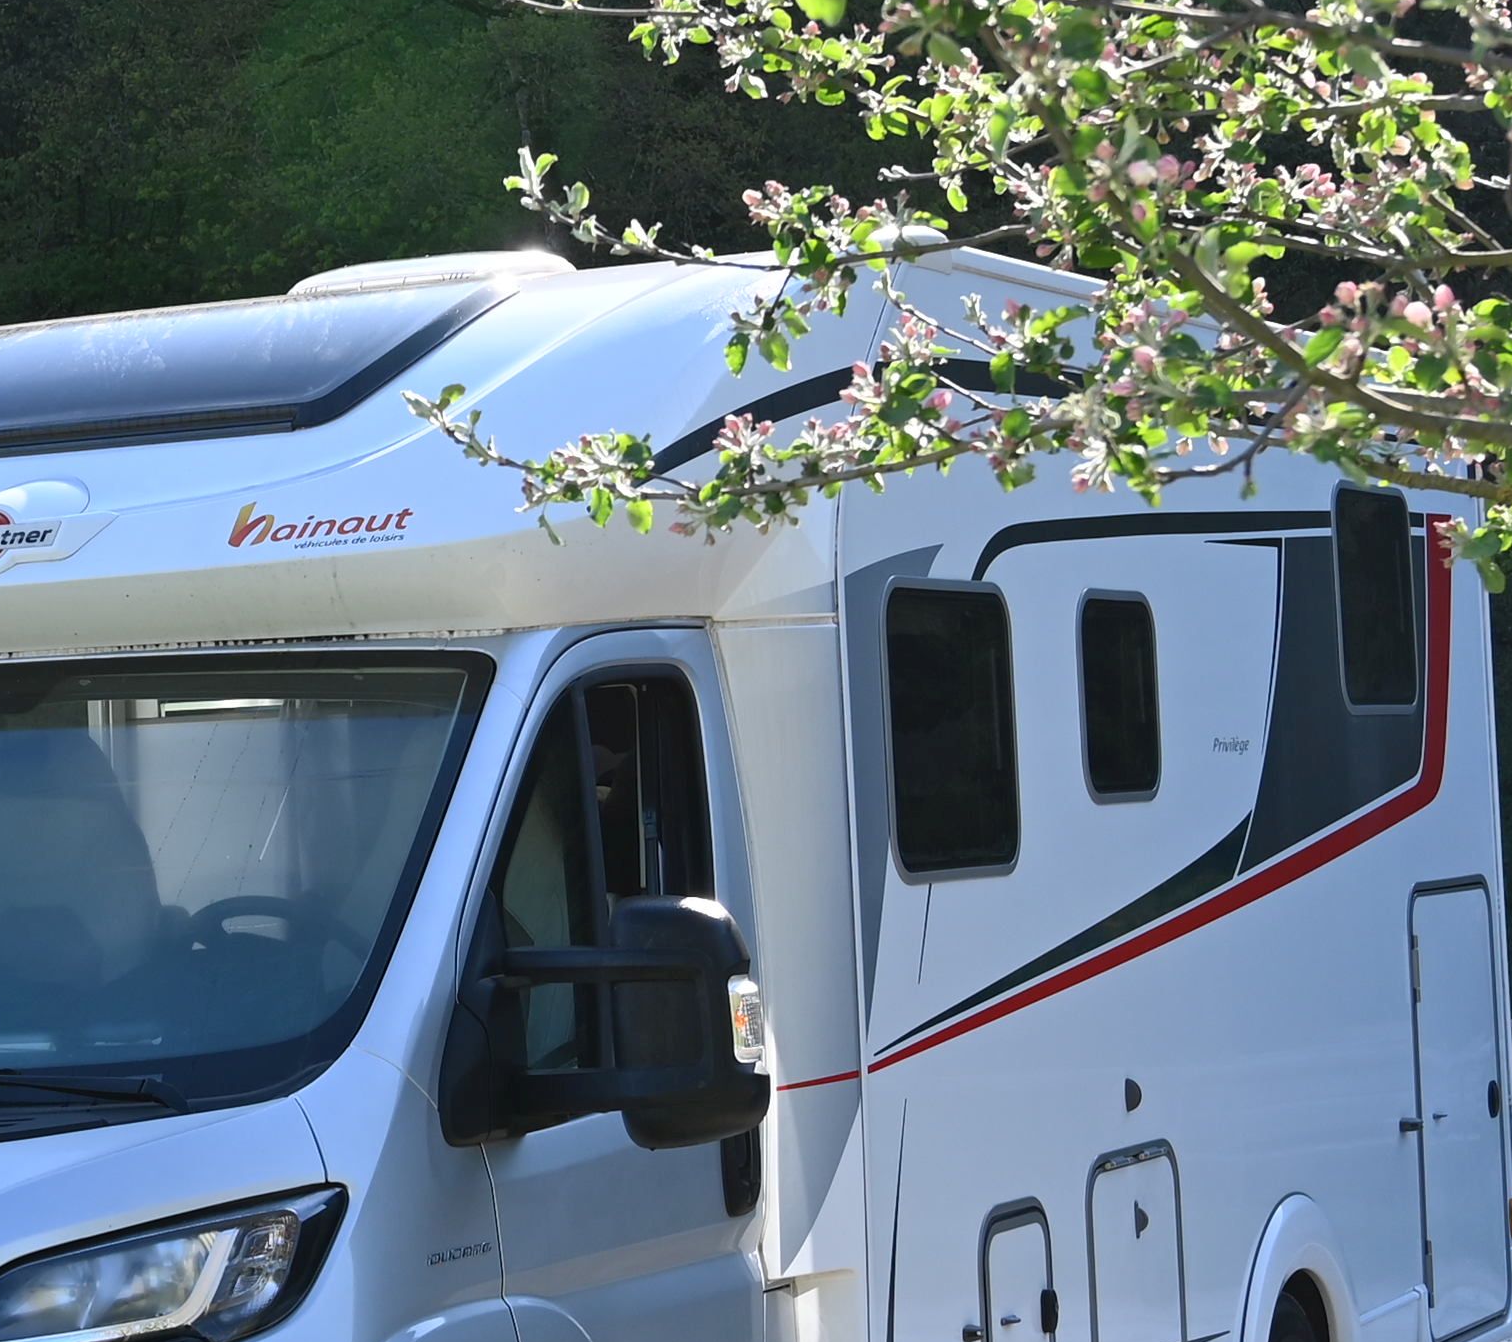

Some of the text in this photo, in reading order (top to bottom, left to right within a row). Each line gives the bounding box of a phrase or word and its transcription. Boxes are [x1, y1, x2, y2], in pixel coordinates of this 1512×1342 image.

[293, 532, 405, 550] véhicules de loisirs
